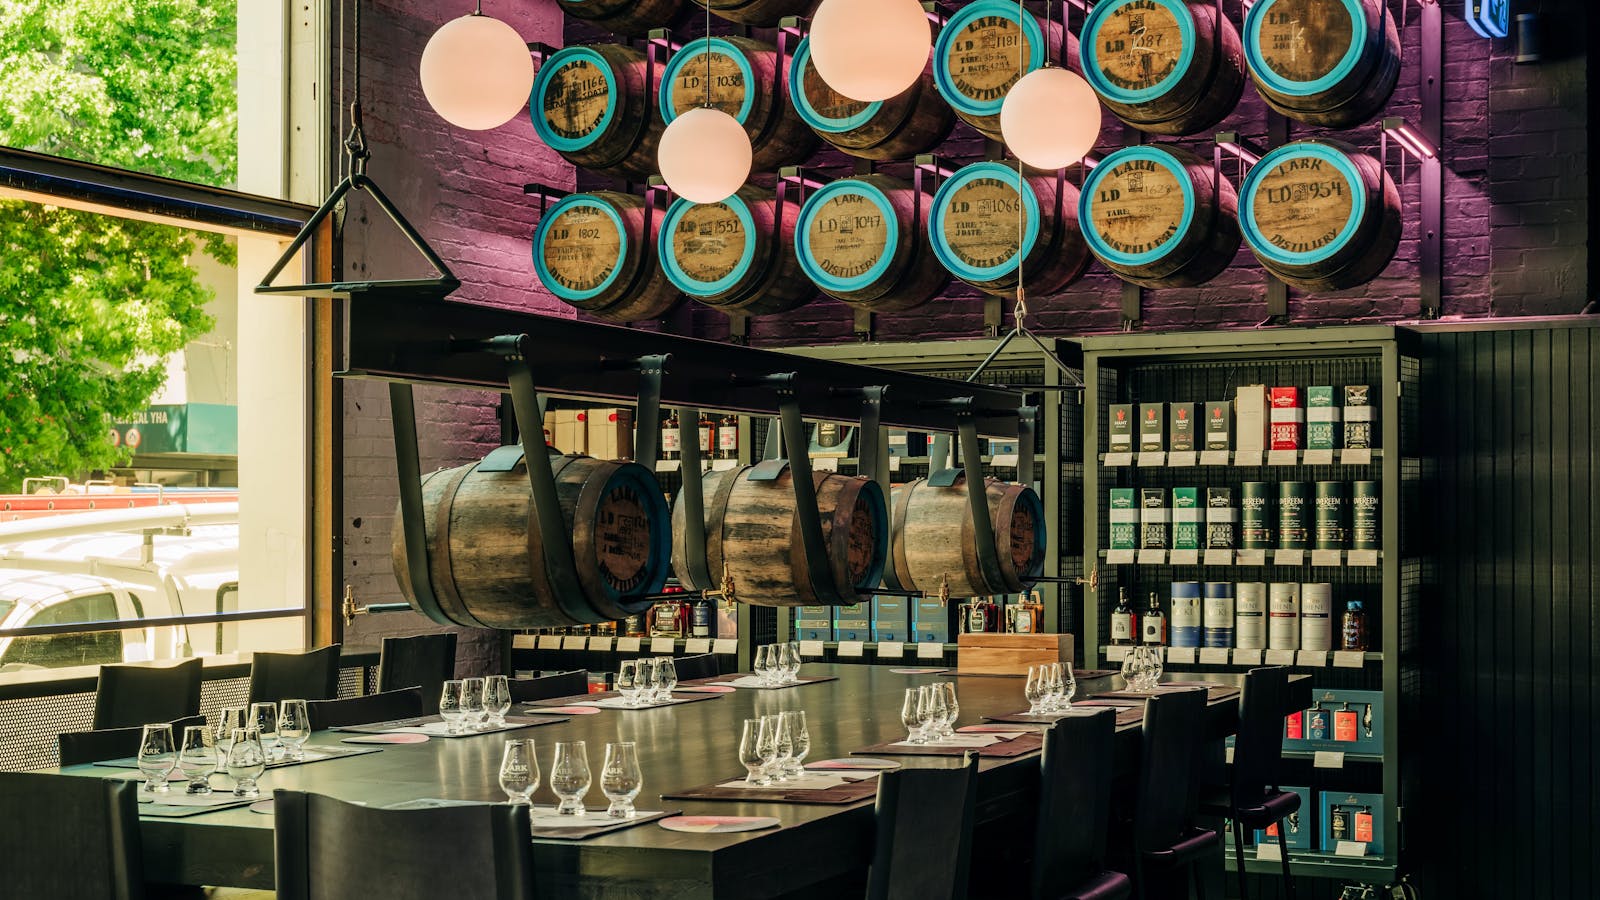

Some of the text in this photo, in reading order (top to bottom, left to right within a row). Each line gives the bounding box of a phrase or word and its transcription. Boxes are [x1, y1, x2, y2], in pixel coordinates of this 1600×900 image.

[1113, 1, 1156, 17] LARK
[968, 16, 1008, 33] LARK
[955, 35, 1017, 52] LD 1181
[1105, 40, 1124, 53] LD
[682, 76, 699, 89] LD
[1112, 160, 1156, 178] LARK
[1278, 157, 1322, 177] LARK
[964, 178, 1005, 191] LARK
[1267, 181, 1342, 205] LD 954
[833, 193, 864, 207] LARK
[1100, 189, 1121, 203] LD
[951, 197, 1019, 214] LD 1066
[819, 215, 881, 233] LD 1047
[553, 227, 601, 240] LD 1802
[1270, 227, 1338, 252] DISTILLERY
[820, 254, 877, 278] DISTILLERY
[151, 411, 168, 424] YHA
